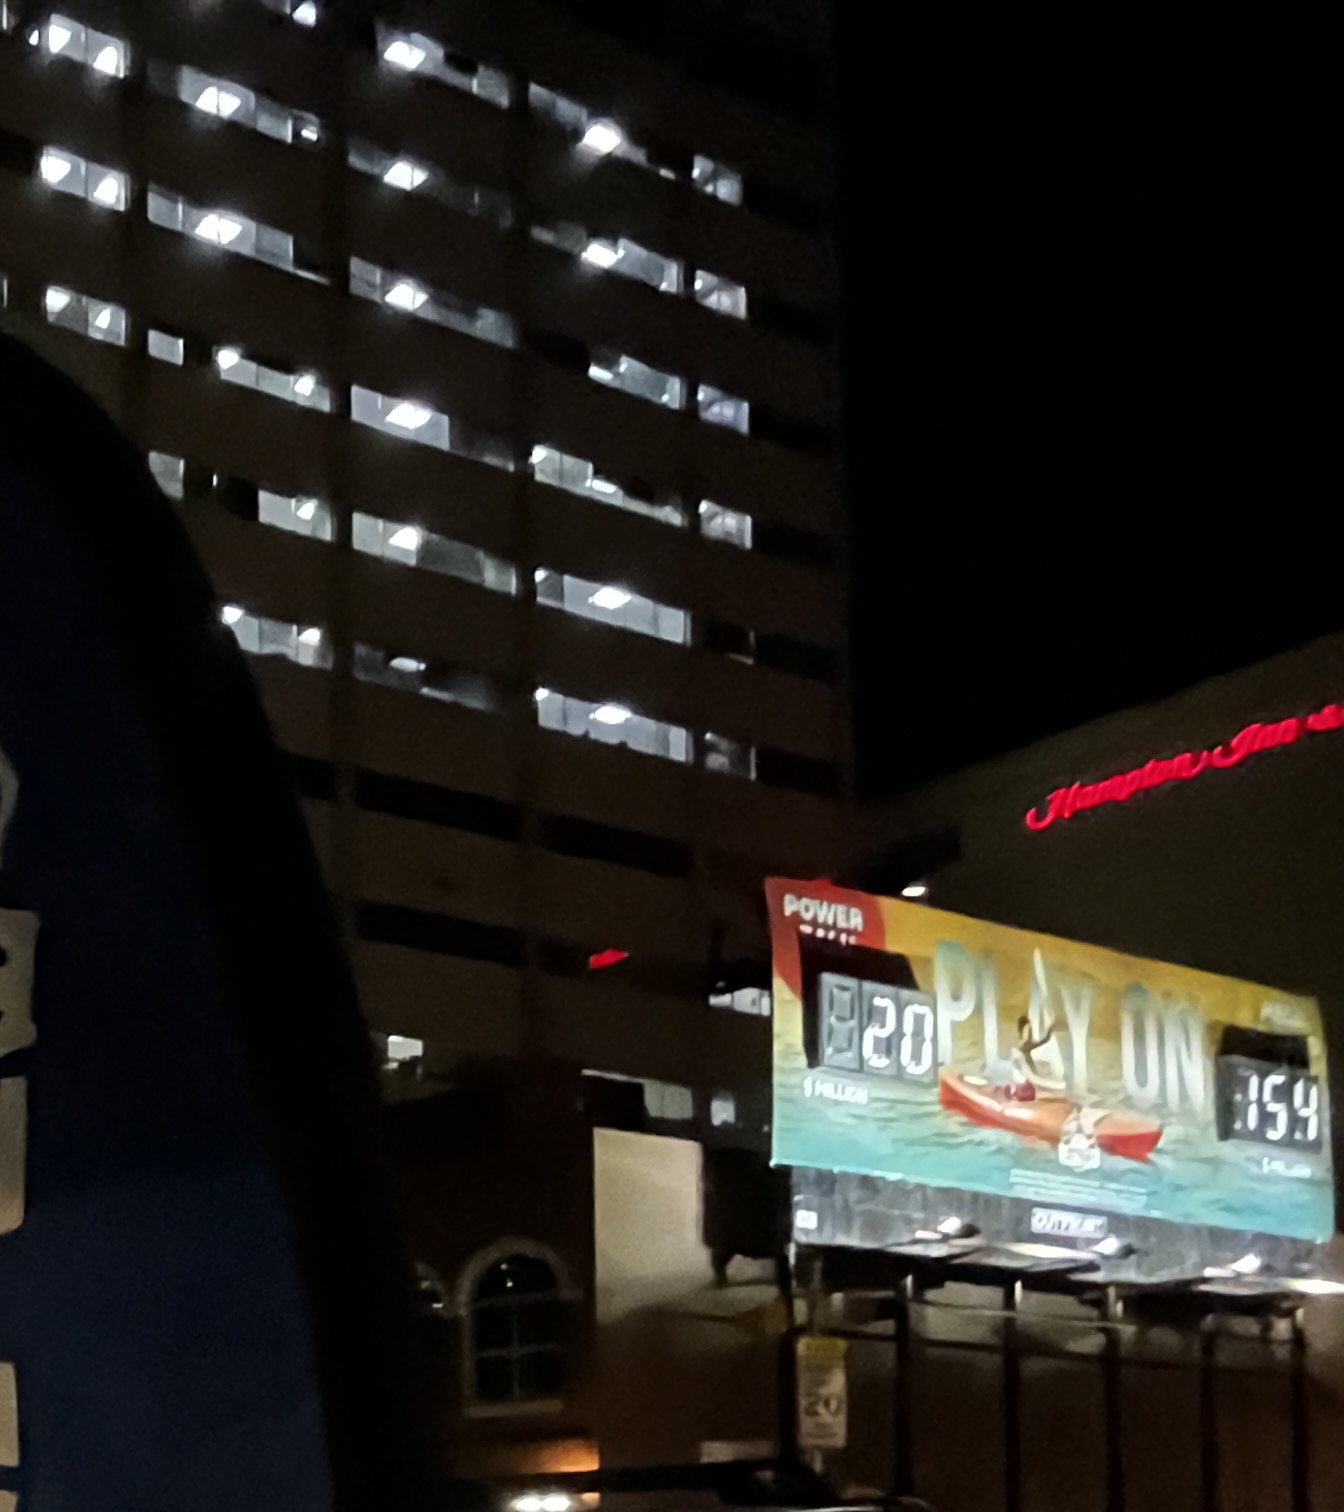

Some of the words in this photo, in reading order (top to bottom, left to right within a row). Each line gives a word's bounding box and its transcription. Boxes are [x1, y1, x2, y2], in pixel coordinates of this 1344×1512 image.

[1025, 751, 1207, 830] Hampton
[1212, 718, 1297, 768] Inn
[783, 893, 863, 931] POWER
[862, 996, 935, 1074] 20
[934, 940, 1092, 1097] PLAY
[1120, 982, 1208, 1112] ON
